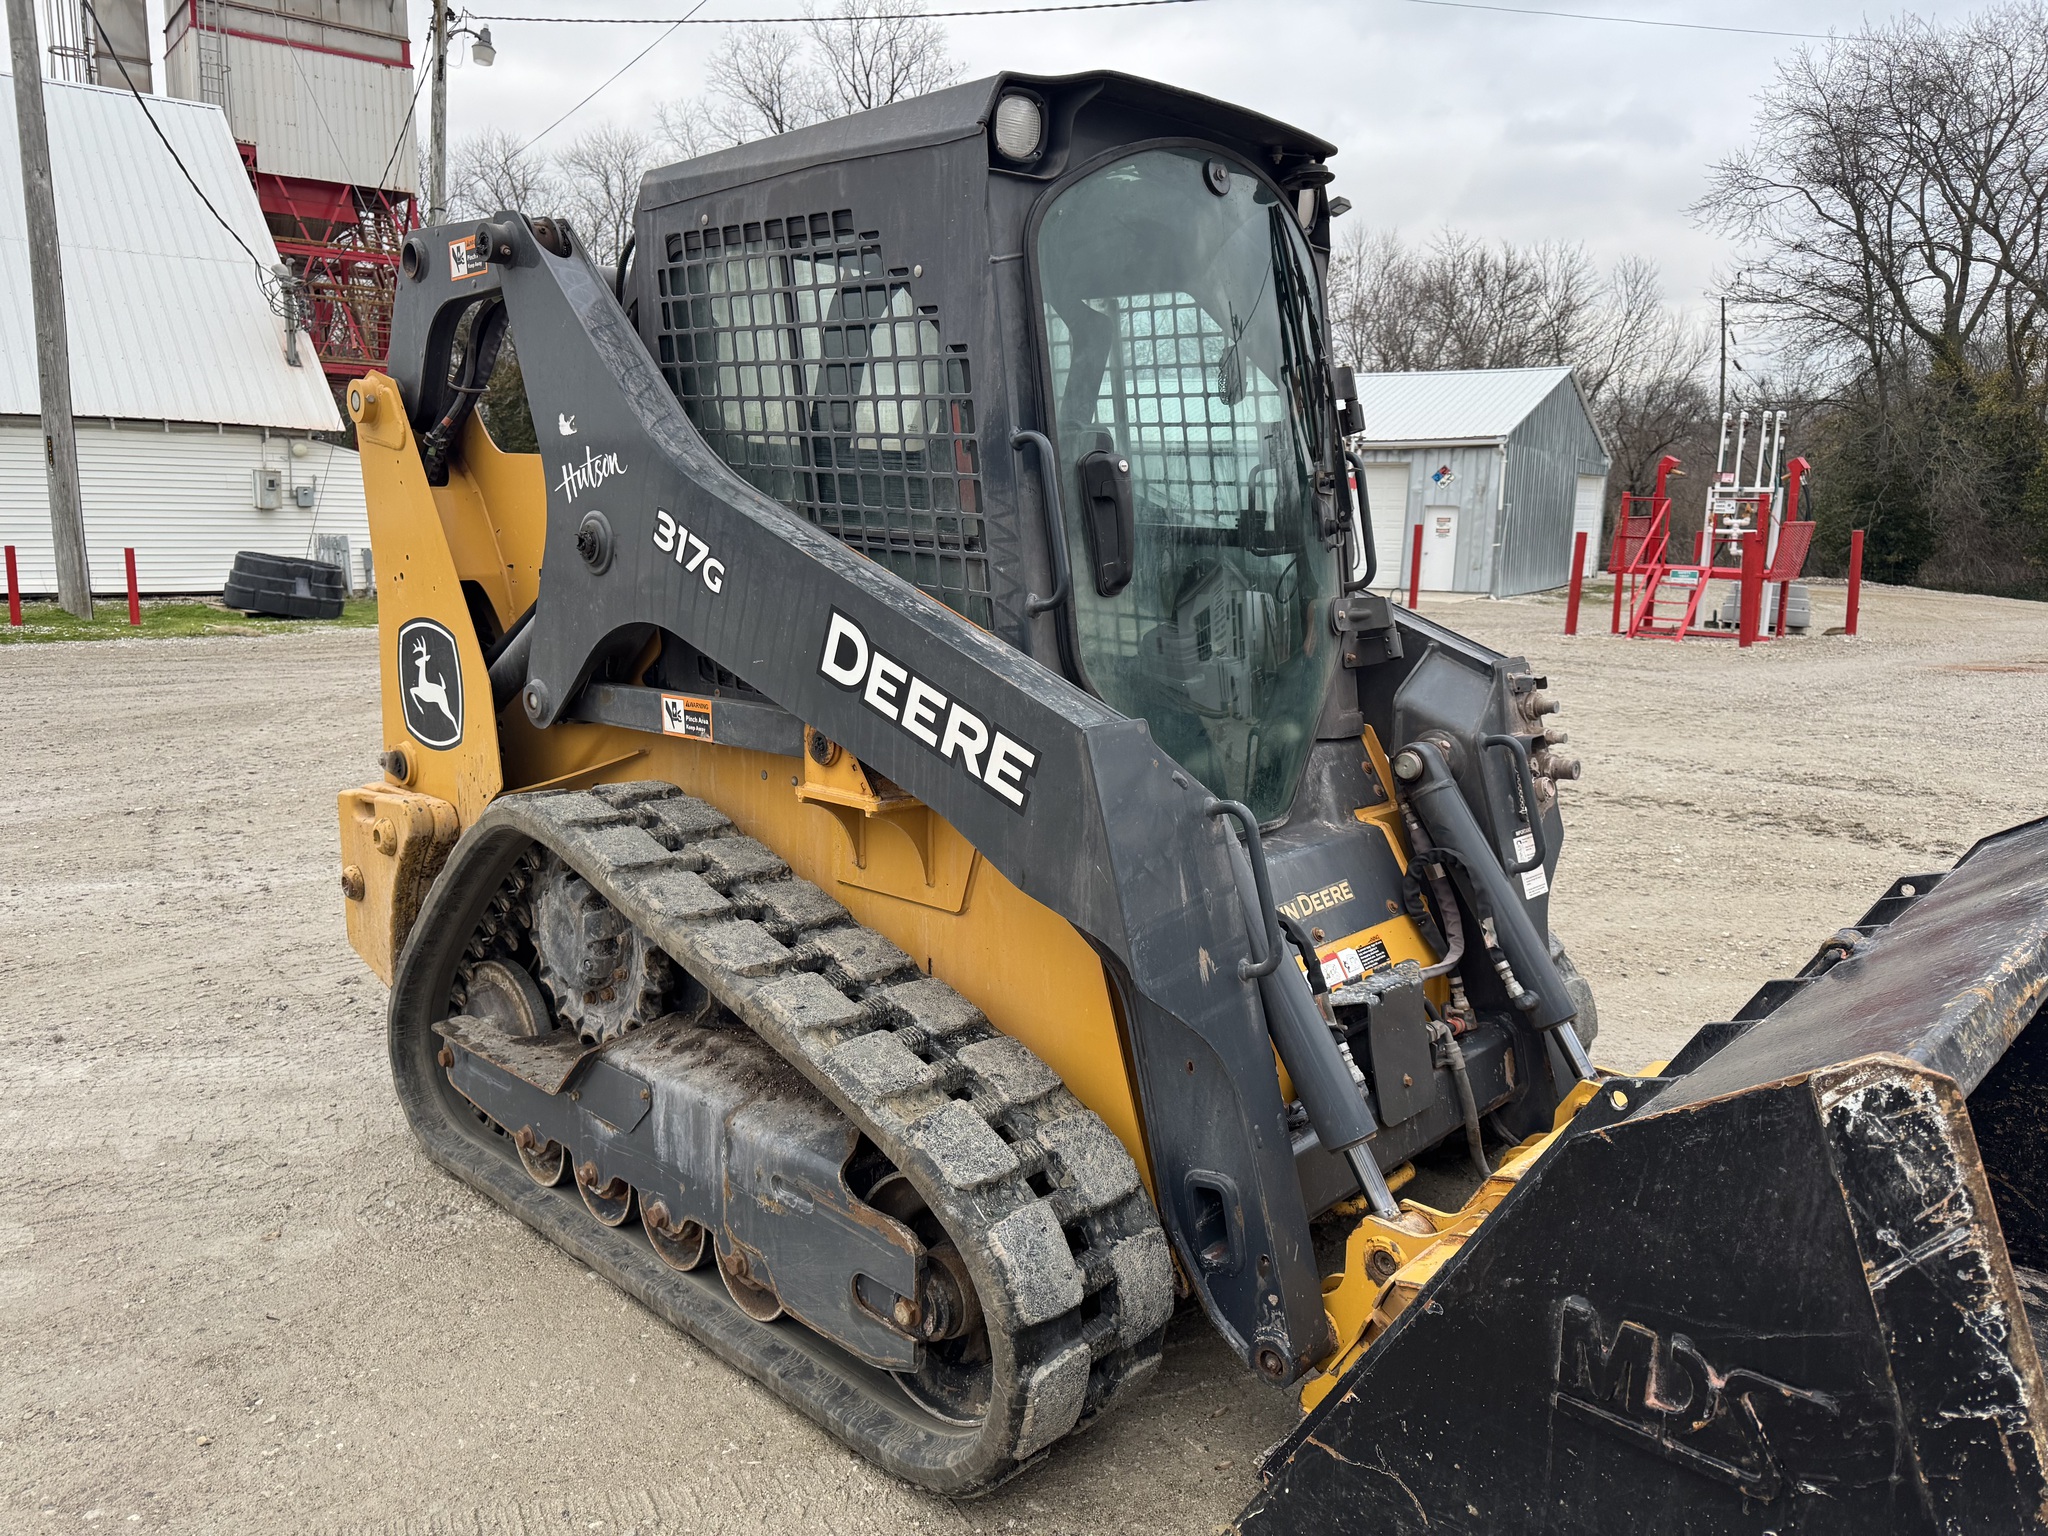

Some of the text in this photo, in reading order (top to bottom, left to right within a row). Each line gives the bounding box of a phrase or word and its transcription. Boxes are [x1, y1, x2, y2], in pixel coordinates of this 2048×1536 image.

[555, 446, 628, 504] Hutson
[653, 510, 726, 594] 317G
[686, 715, 709, 725] Pinch Area
[821, 612, 1036, 807] DEERE
[1296, 881, 1354, 917] DEERE
